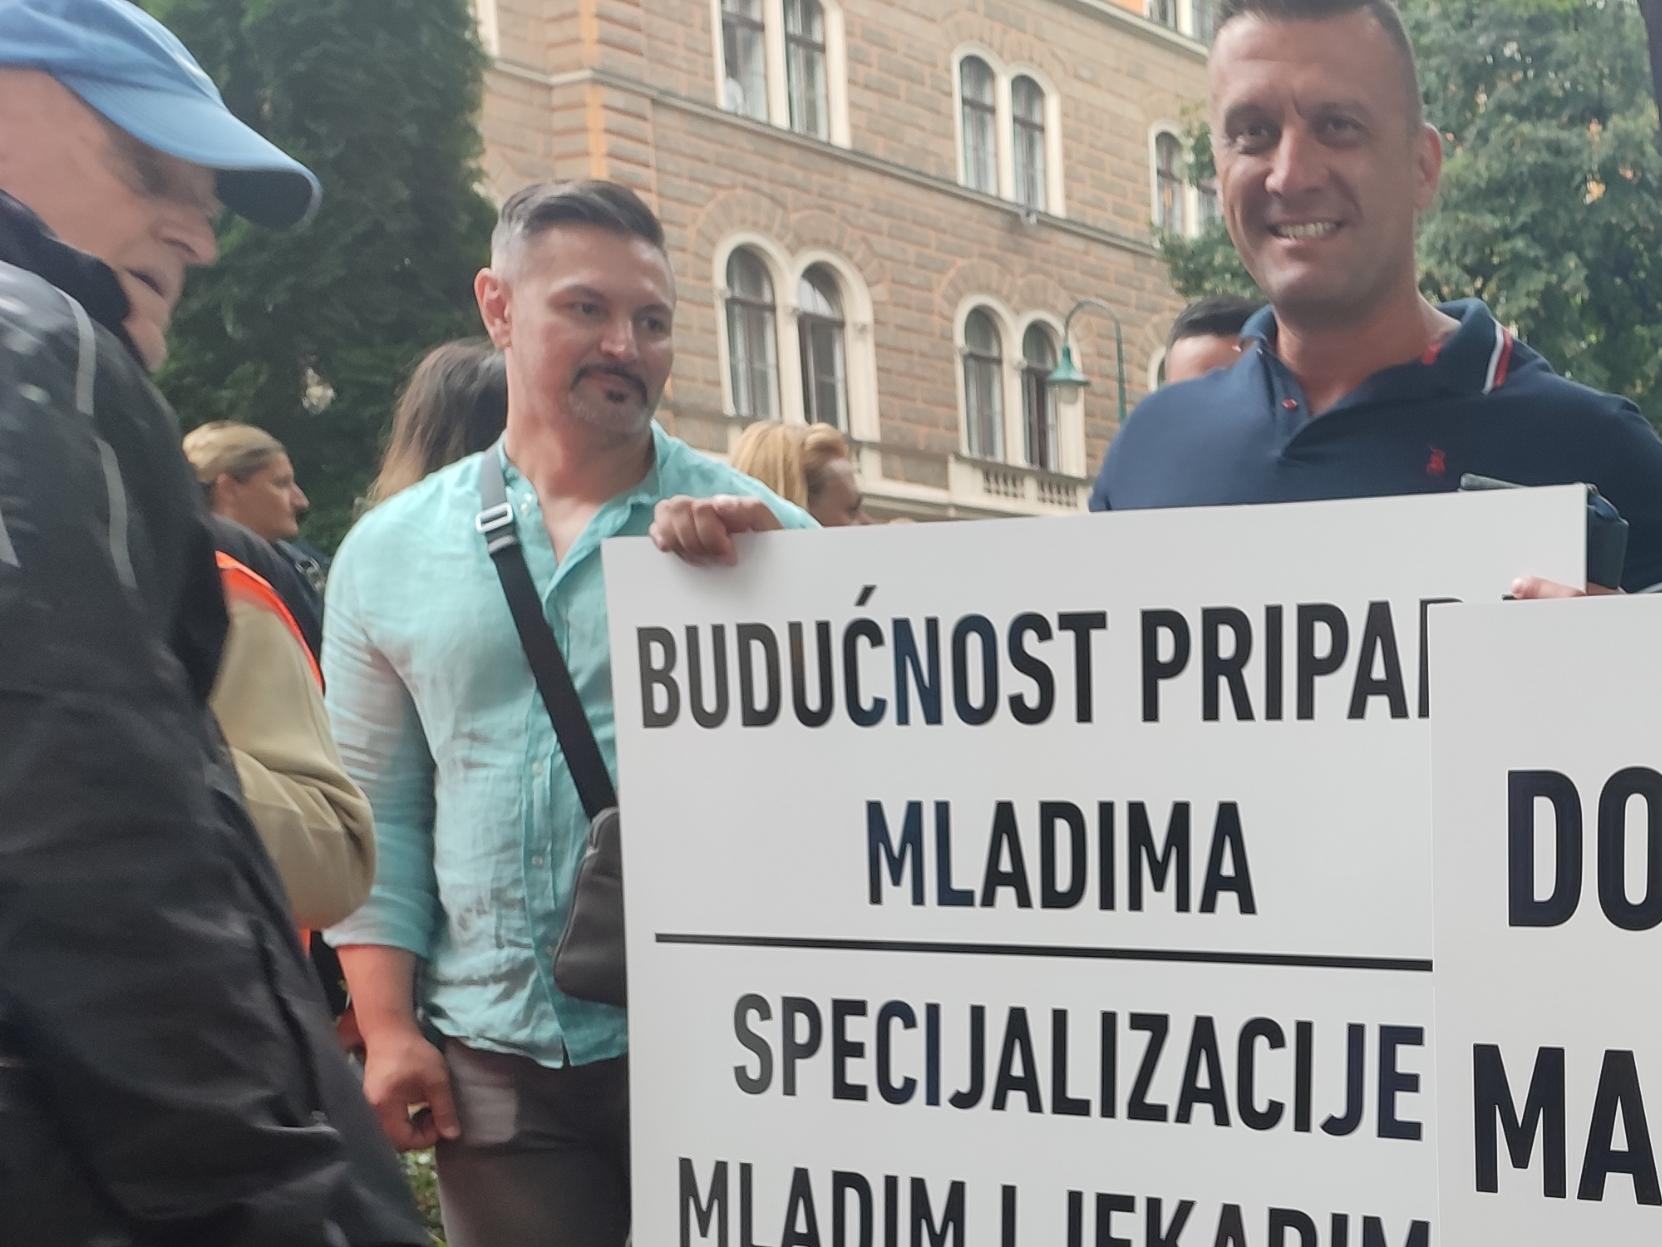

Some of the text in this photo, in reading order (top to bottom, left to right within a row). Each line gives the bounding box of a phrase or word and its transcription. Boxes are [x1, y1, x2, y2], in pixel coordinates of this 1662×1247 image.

[636, 585, 1516, 729] BUDUĆNOST PRIPA
[866, 800, 1257, 915] MLADIMA
[733, 993, 1425, 1142] SPECIJALIZACIJE
